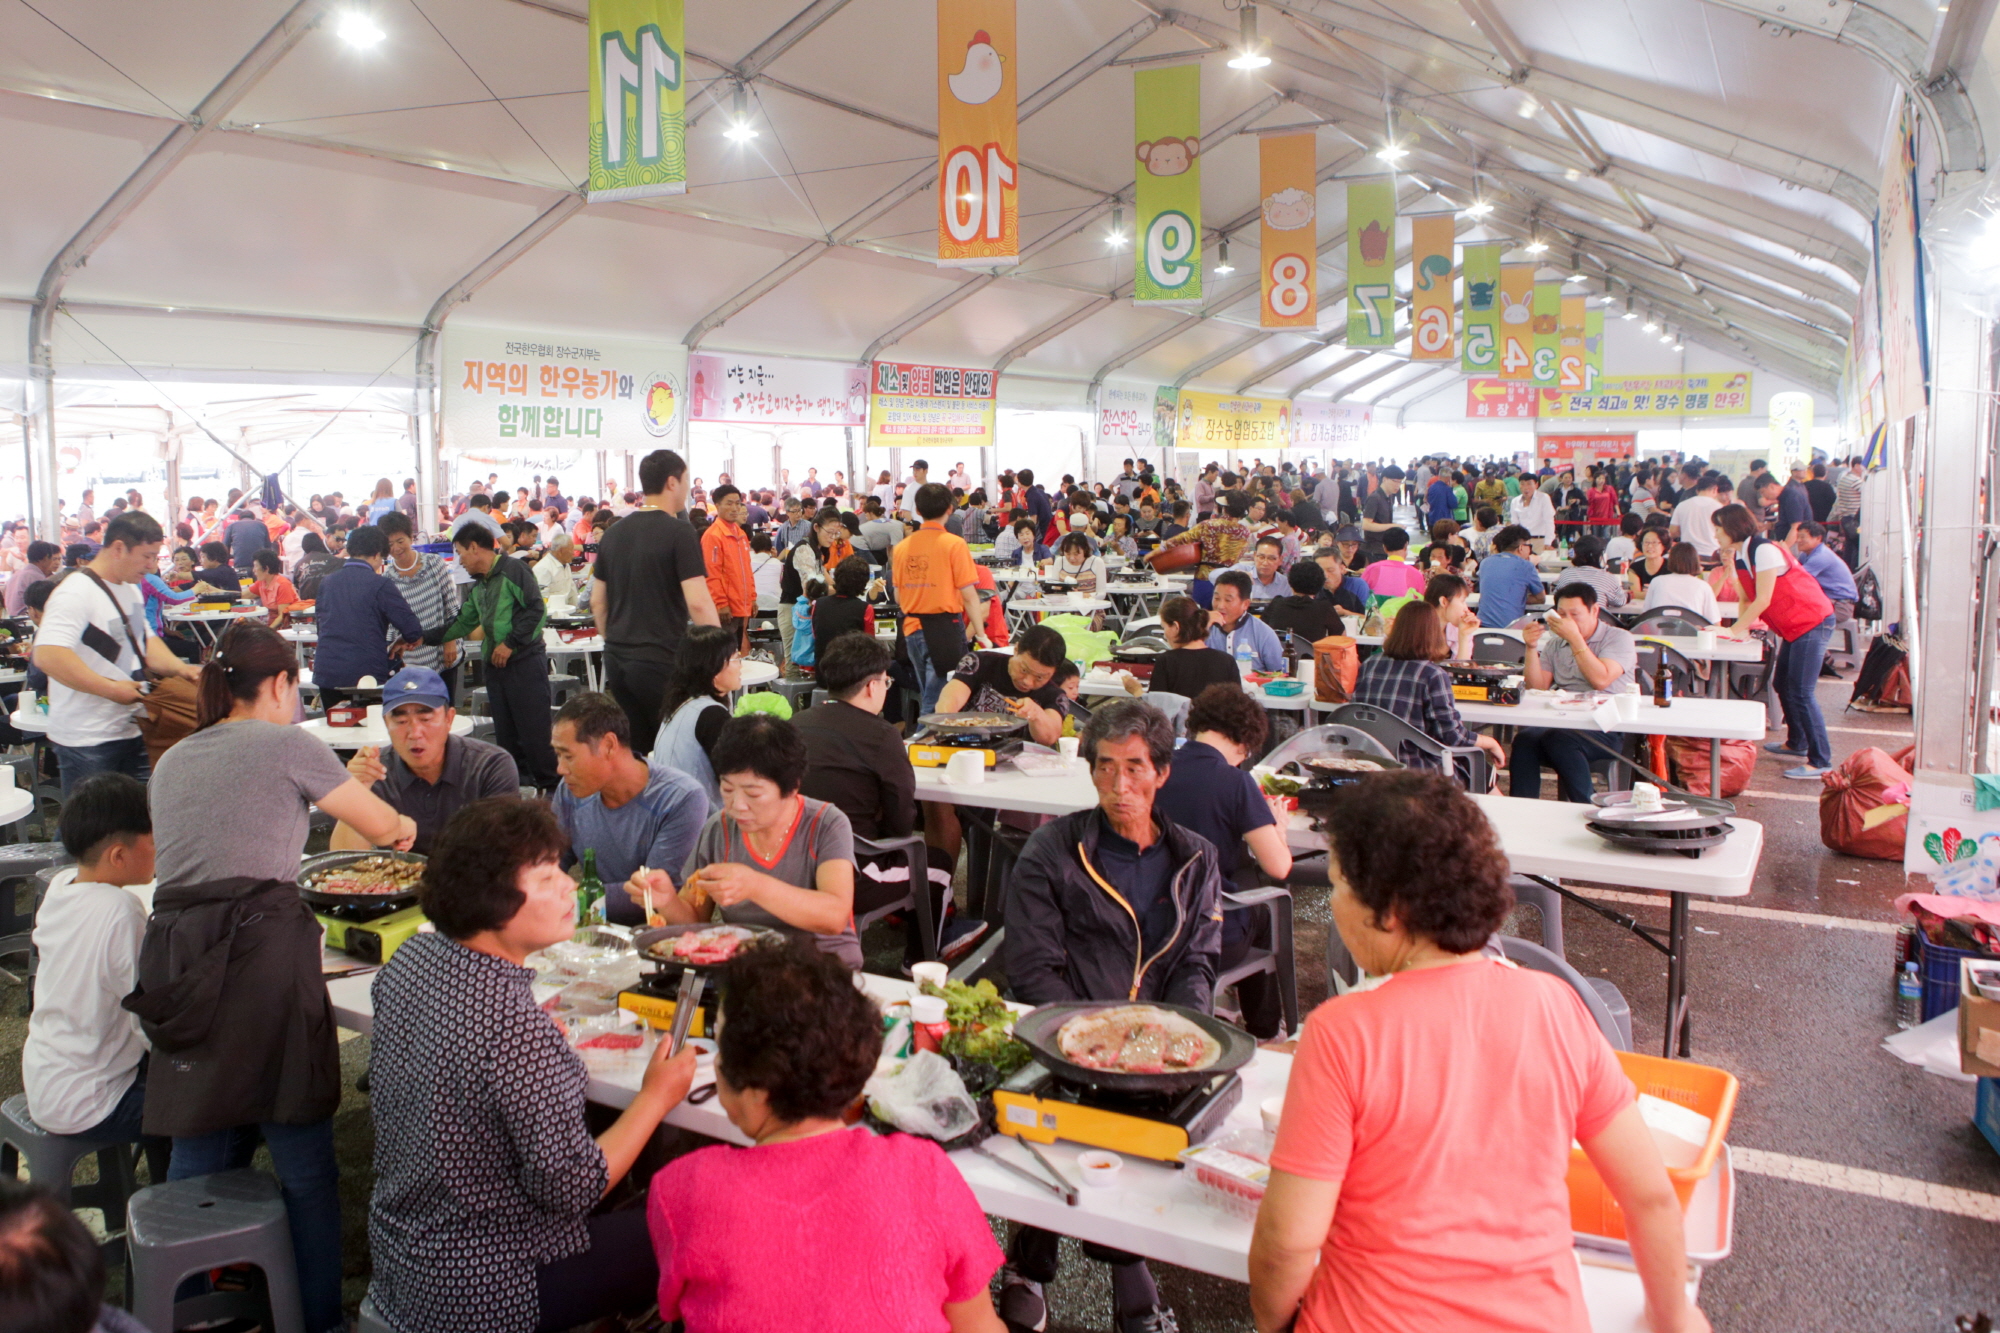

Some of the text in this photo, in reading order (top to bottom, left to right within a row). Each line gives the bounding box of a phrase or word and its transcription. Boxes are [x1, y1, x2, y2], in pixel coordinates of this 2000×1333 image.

[505, 341, 602, 361] 전국한우협회 장수군지부는
[462, 360, 634, 401] 지역의 한우농가와
[727, 363, 745, 385] 너는
[879, 364, 993, 398] 채소 및 양념 반입은 안돼요!
[878, 397, 888, 407] 채소
[889, 398, 894, 408] 및
[895, 398, 905, 409] 양념
[906, 398, 915, 409] 구입
[916, 399, 929, 409] 비용에
[966, 401, 978, 411] 서비스
[1570, 396, 1593, 411] 전국
[1633, 395, 1651, 410] 맛!
[1655, 393, 1680, 410] 장수
[1684, 392, 1709, 410] 명품
[1714, 391, 1745, 408] 한우!
[497, 404, 603, 438] 함께합니다
[913, 412, 921, 422] 채소
[928, 412, 941, 423] 양념은
[1102, 408, 1152, 436] 장수한우입니다
[1205, 418, 1275, 442] 장수농업협동조합
